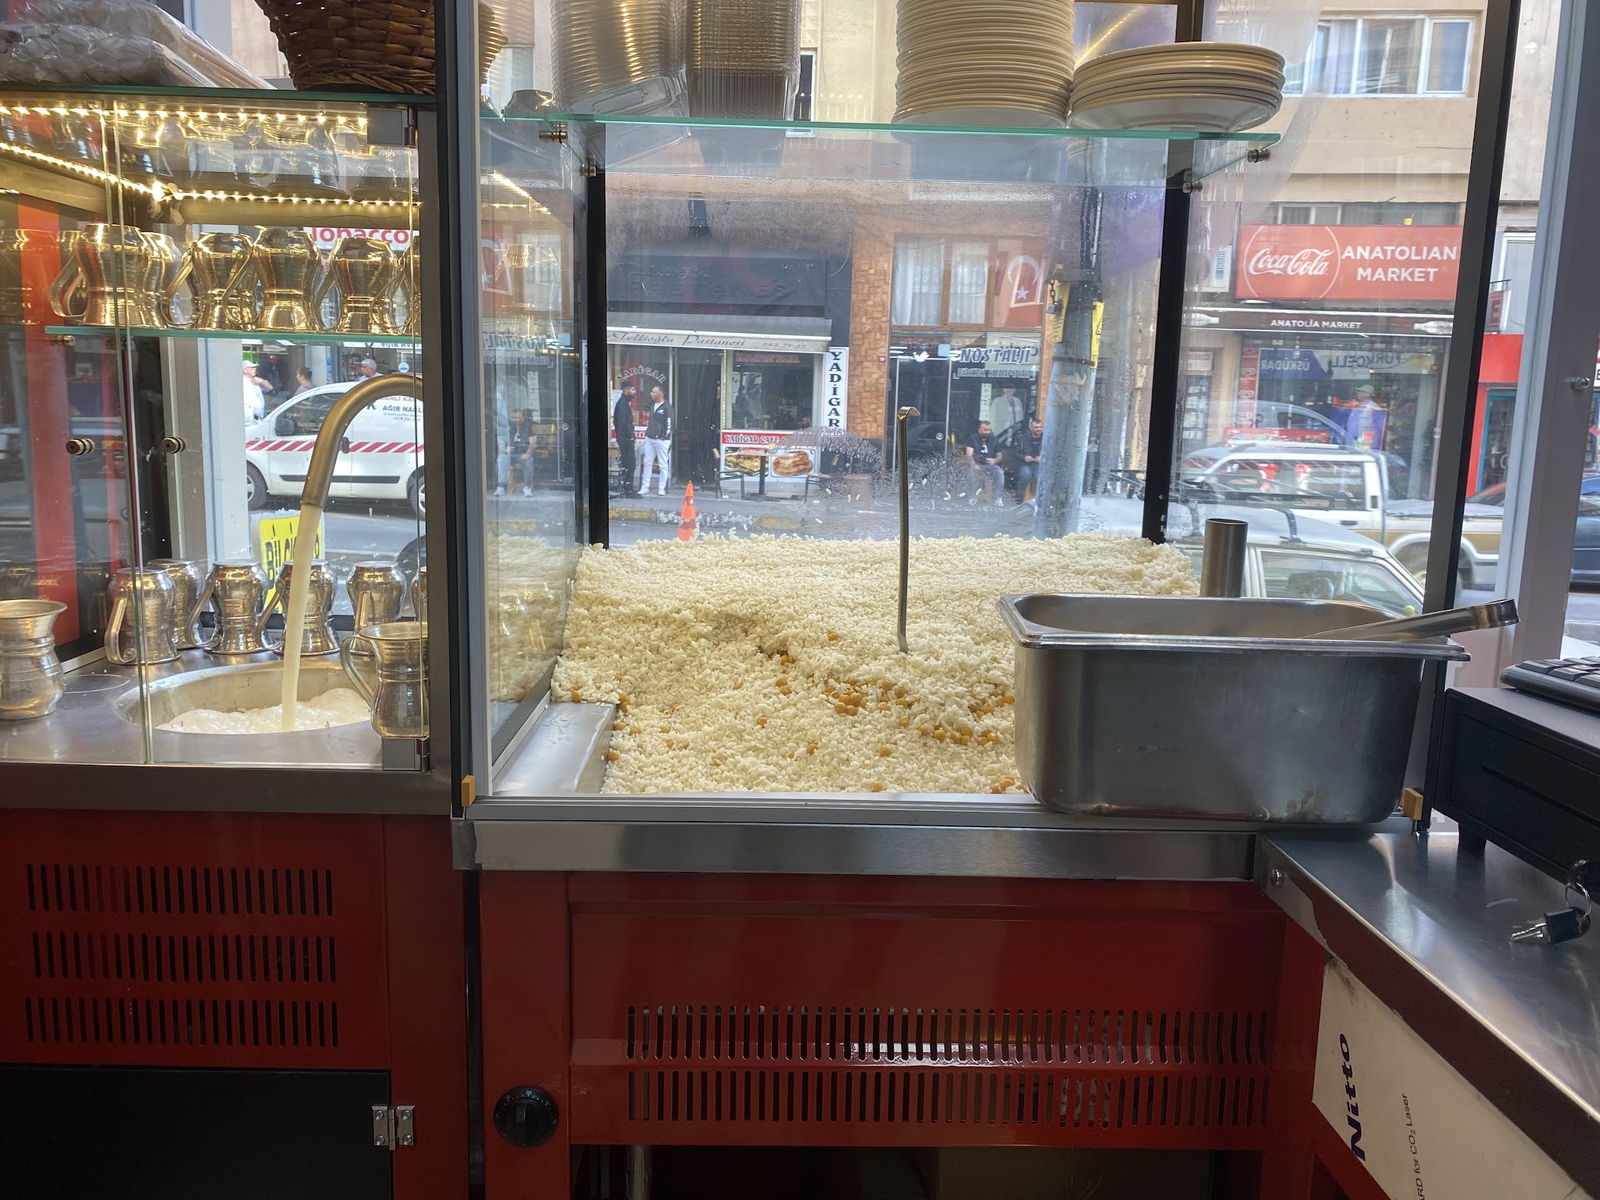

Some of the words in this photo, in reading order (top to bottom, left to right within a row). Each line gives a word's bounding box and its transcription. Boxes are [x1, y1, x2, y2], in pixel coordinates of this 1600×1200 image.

[1249, 248, 1335, 276] Coca-Cola
[1341, 245, 1457, 261] ANATOLIAN
[1357, 267, 1439, 282] MARKET
[1321, 320, 1364, 330] MARKET
[683, 333, 746, 347] Pastanesi
[829, 351, 844, 428] YADİGAR
[1340, 1033, 1366, 1161] Nitto
[1402, 1094, 1413, 1127] Laser
